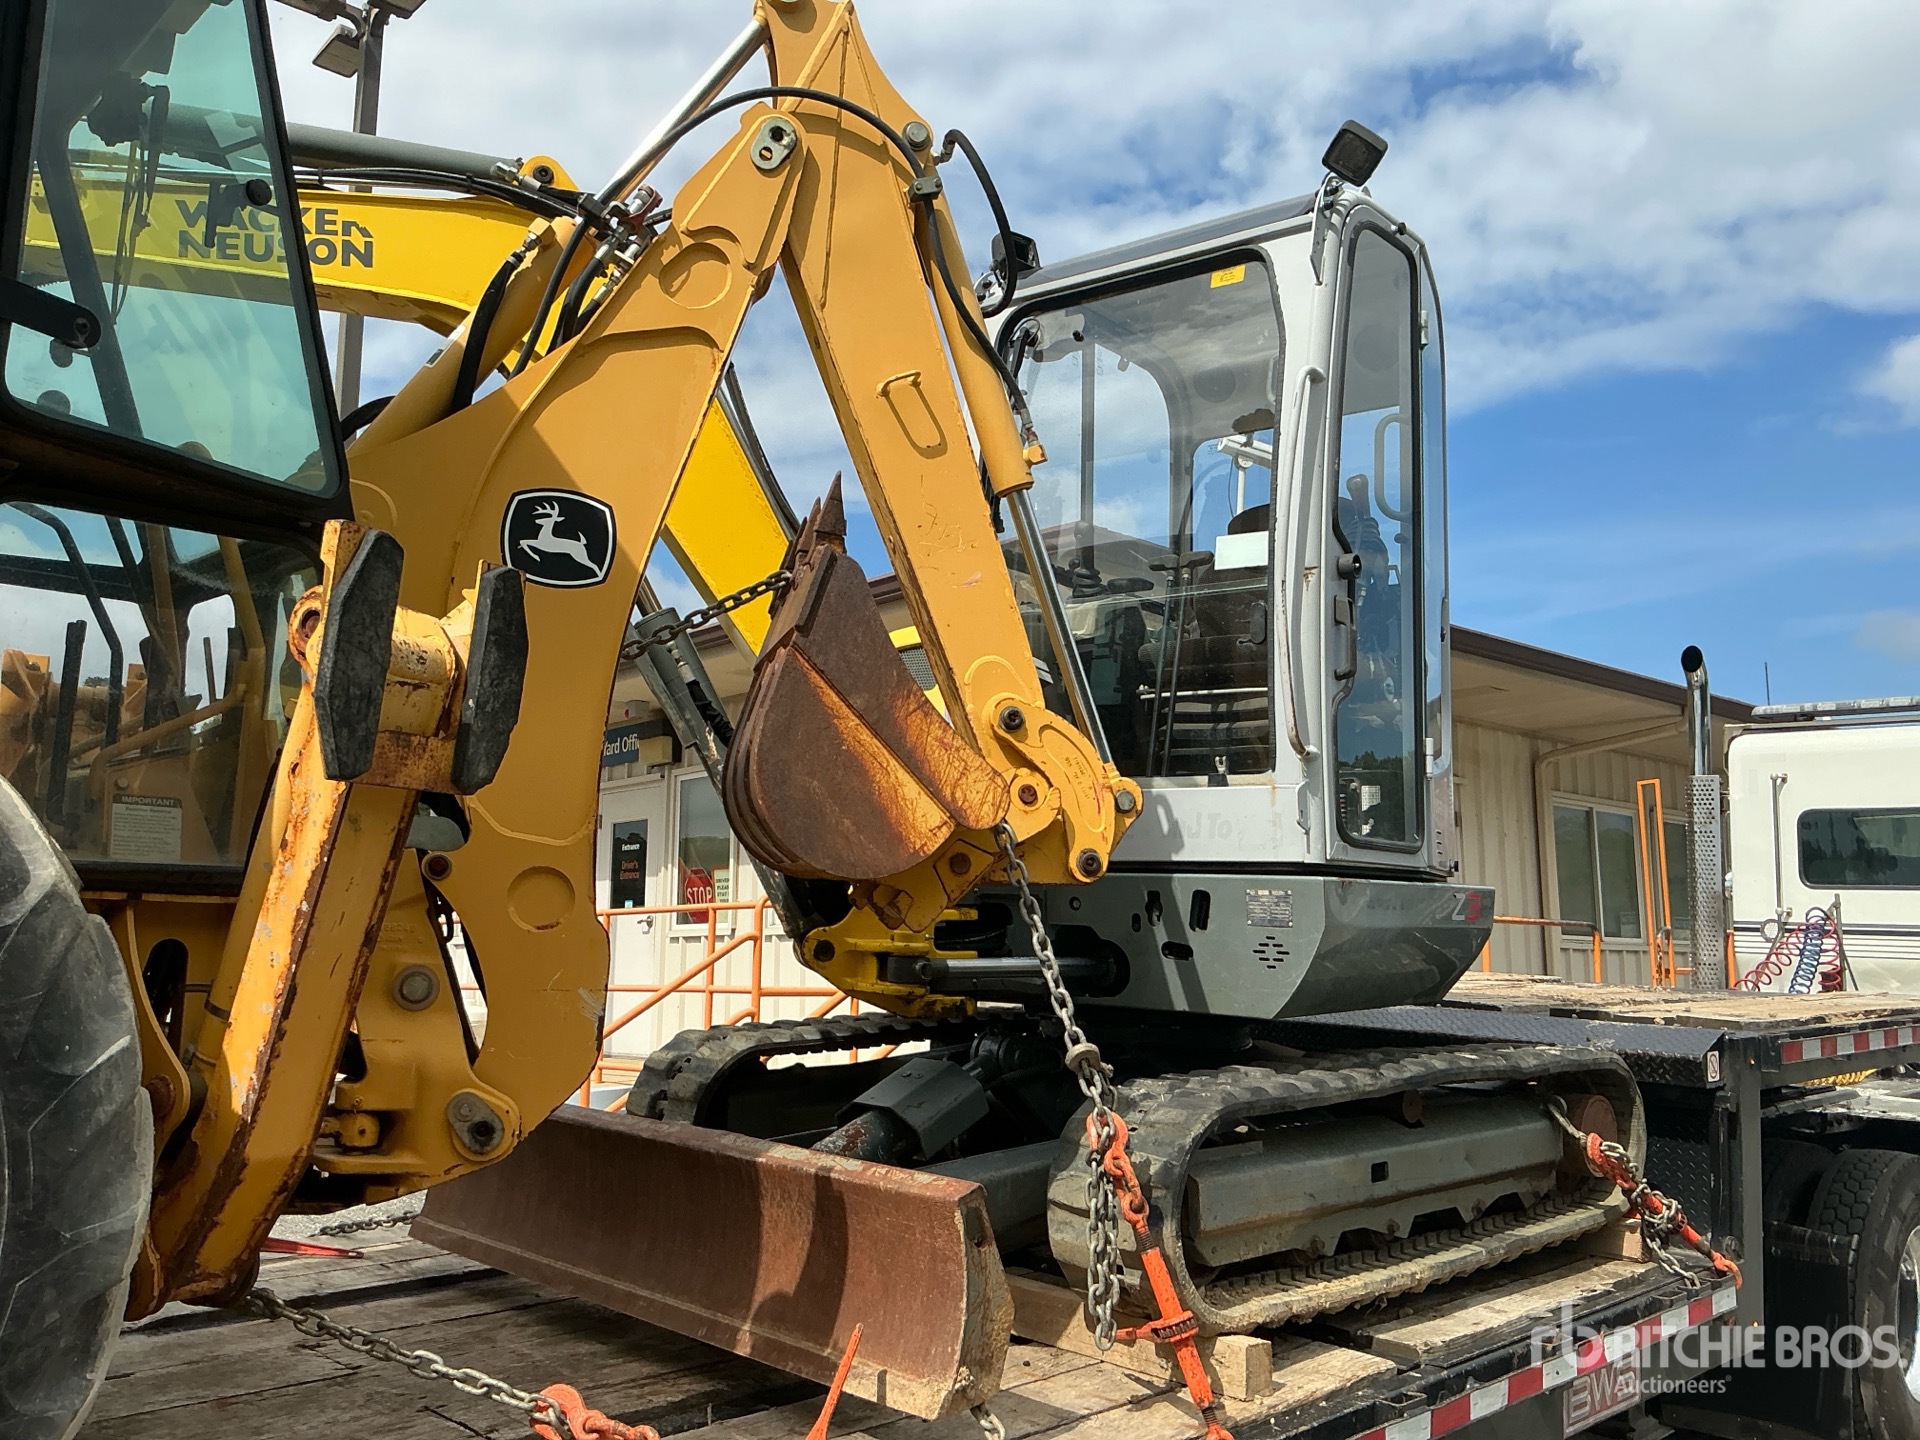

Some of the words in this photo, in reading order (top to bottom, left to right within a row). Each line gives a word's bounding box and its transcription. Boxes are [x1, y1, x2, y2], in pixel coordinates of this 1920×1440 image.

[122, 796, 174, 806] IMPORTANT
[621, 843, 640, 851] Entrance
[687, 886, 712, 905] STOP
